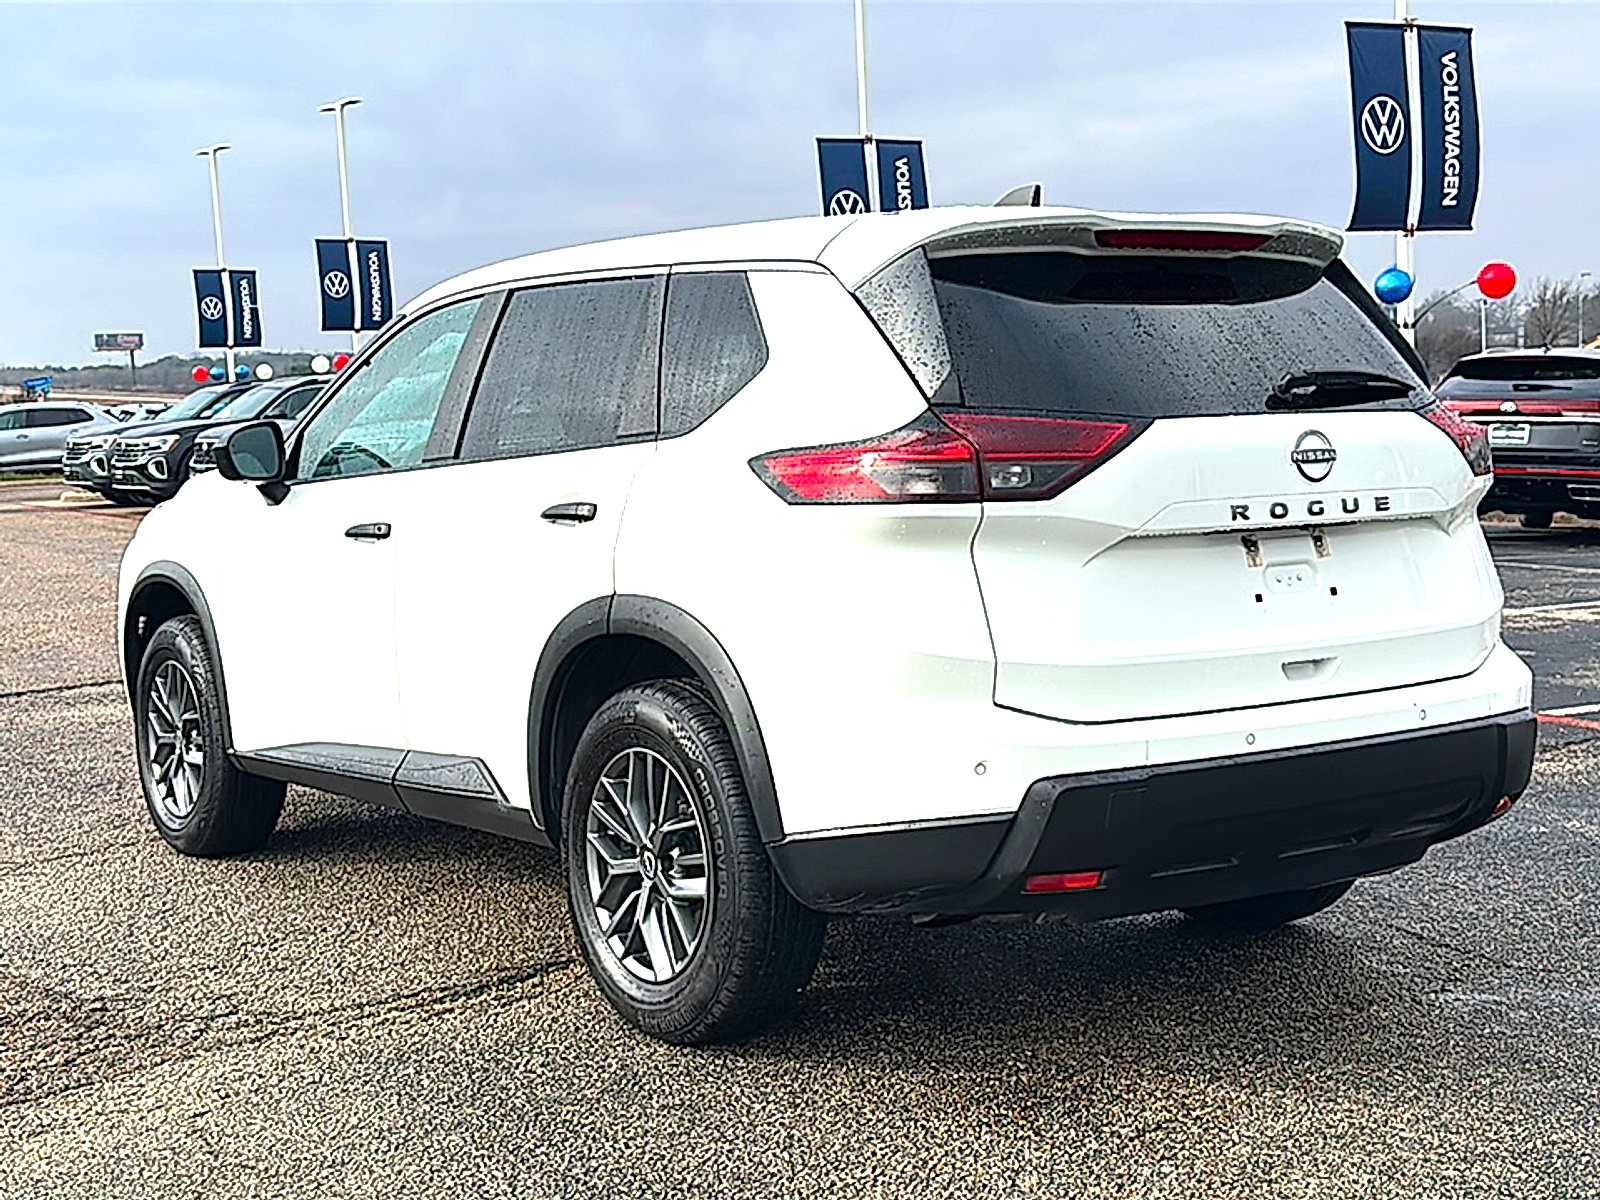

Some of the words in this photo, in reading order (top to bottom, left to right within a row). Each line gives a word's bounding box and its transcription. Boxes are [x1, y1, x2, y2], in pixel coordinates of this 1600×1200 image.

[1441, 51, 1461, 207] VOLKSWAGEN
[239, 277, 253, 339] VOLKSWAGEN
[368, 251, 382, 322] VOLKSWAGEN
[1292, 449, 1337, 462] NISSAN
[1230, 496, 1391, 521] ROGUE
